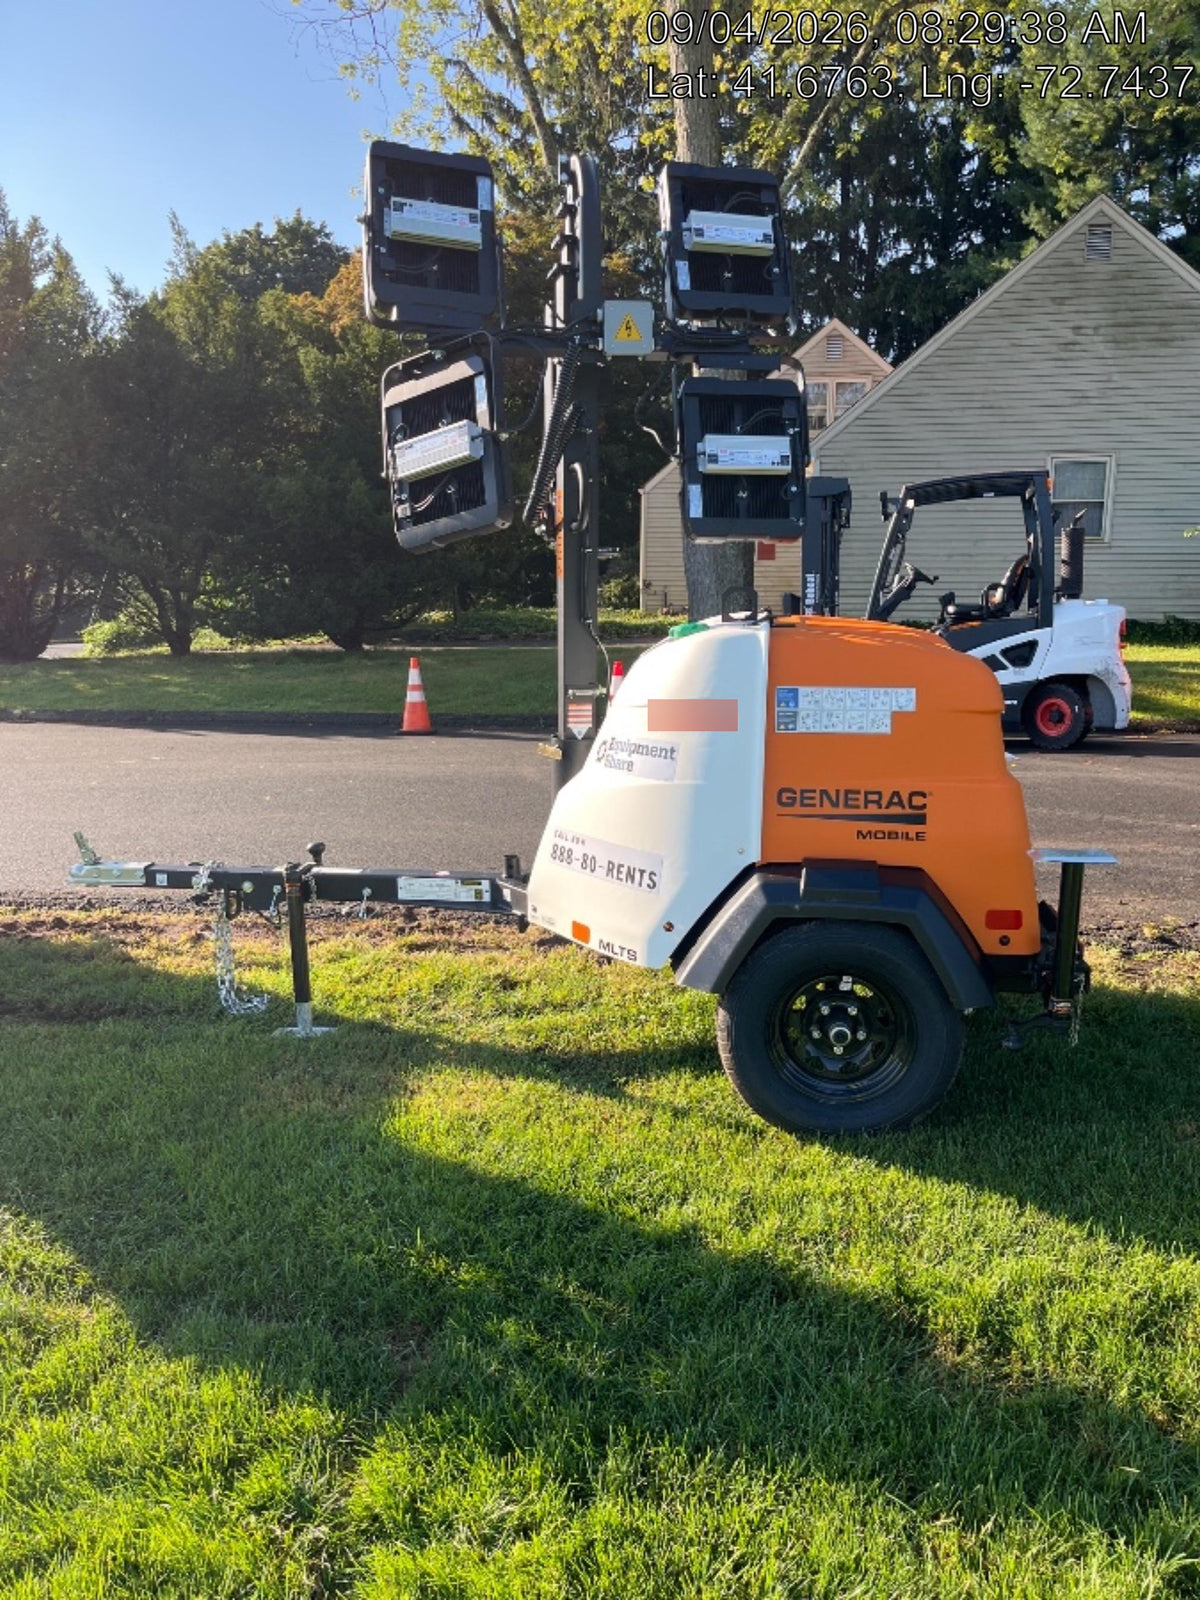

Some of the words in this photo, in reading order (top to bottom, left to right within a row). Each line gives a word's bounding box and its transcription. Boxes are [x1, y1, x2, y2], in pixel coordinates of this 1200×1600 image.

[608, 736, 677, 761] Equipment
[604, 753, 634, 773] Share
[776, 787, 928, 812] GENERAC
[856, 829, 927, 842] MOBILE
[550, 842, 658, 891] 888-80-RENTS
[598, 938, 638, 962] MLTS
